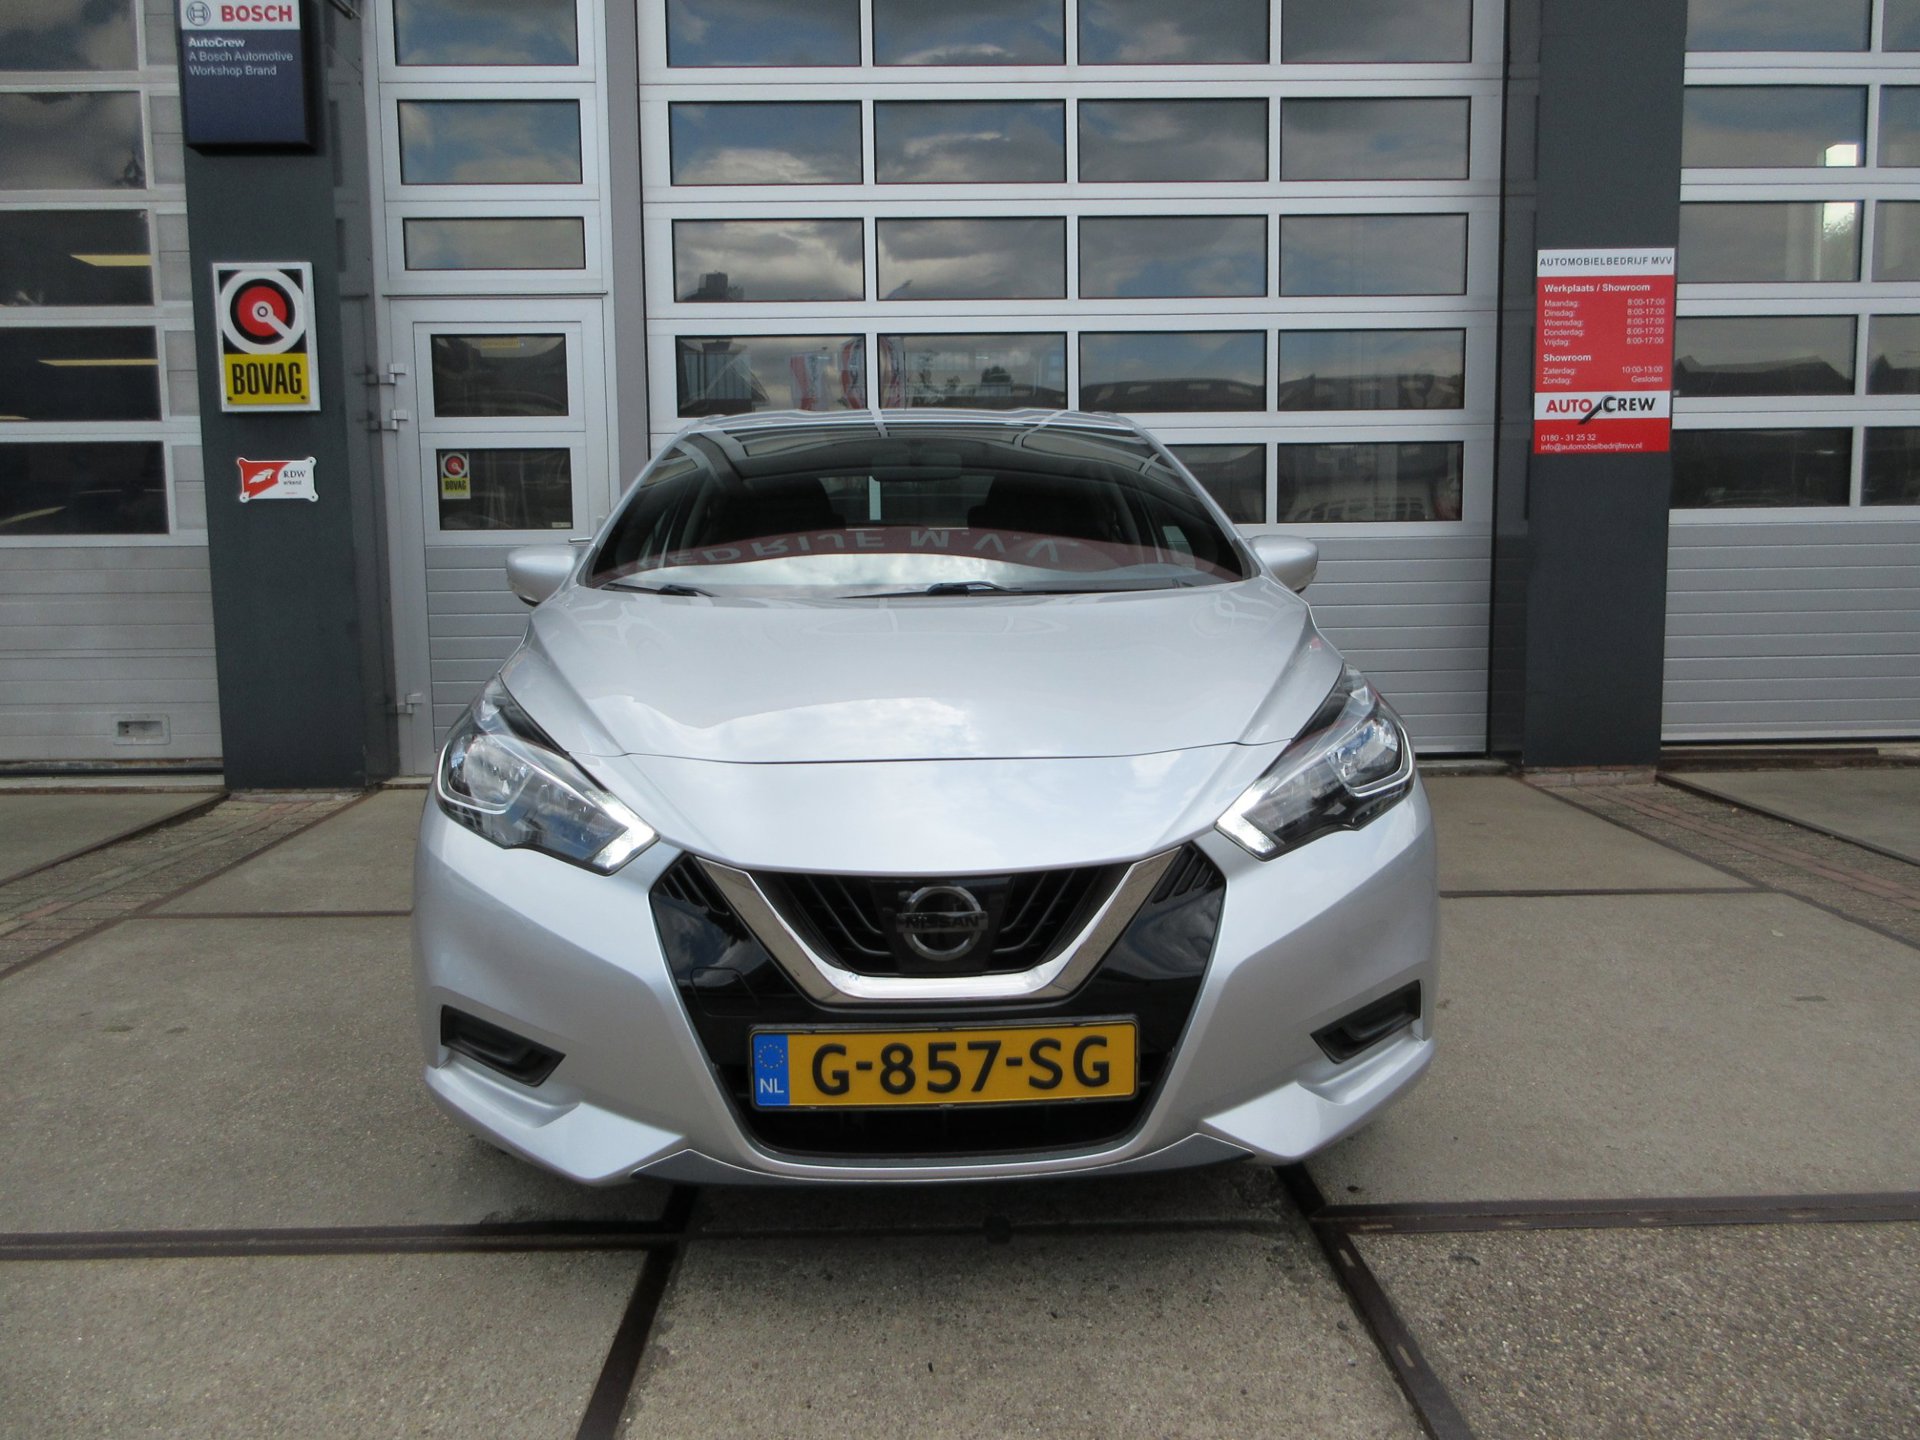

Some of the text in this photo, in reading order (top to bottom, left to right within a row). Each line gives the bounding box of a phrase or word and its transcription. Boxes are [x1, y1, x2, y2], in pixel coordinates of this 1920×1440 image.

[221, 5, 293, 22] BOSCH
[188, 38, 246, 48] AutoCrew
[189, 51, 294, 61] A Bosch Automotive
[189, 66, 277, 77] Workshop Brand
[1540, 256, 1673, 267] AUTOMOBIELBEDRIJF MVV
[1544, 284, 1595, 294] Werkplaats
[1602, 284, 1650, 292] Showroom
[1543, 354, 1592, 362] Showroom
[231, 362, 303, 395] BOVAG
[1631, 375, 1663, 383] Gesloten
[1546, 396, 1656, 413] AUTO CREW
[283, 470, 306, 478] RDW
[445, 480, 467, 491] BOVAG
[760, 1035, 1110, 1097] NL G-857-SG
